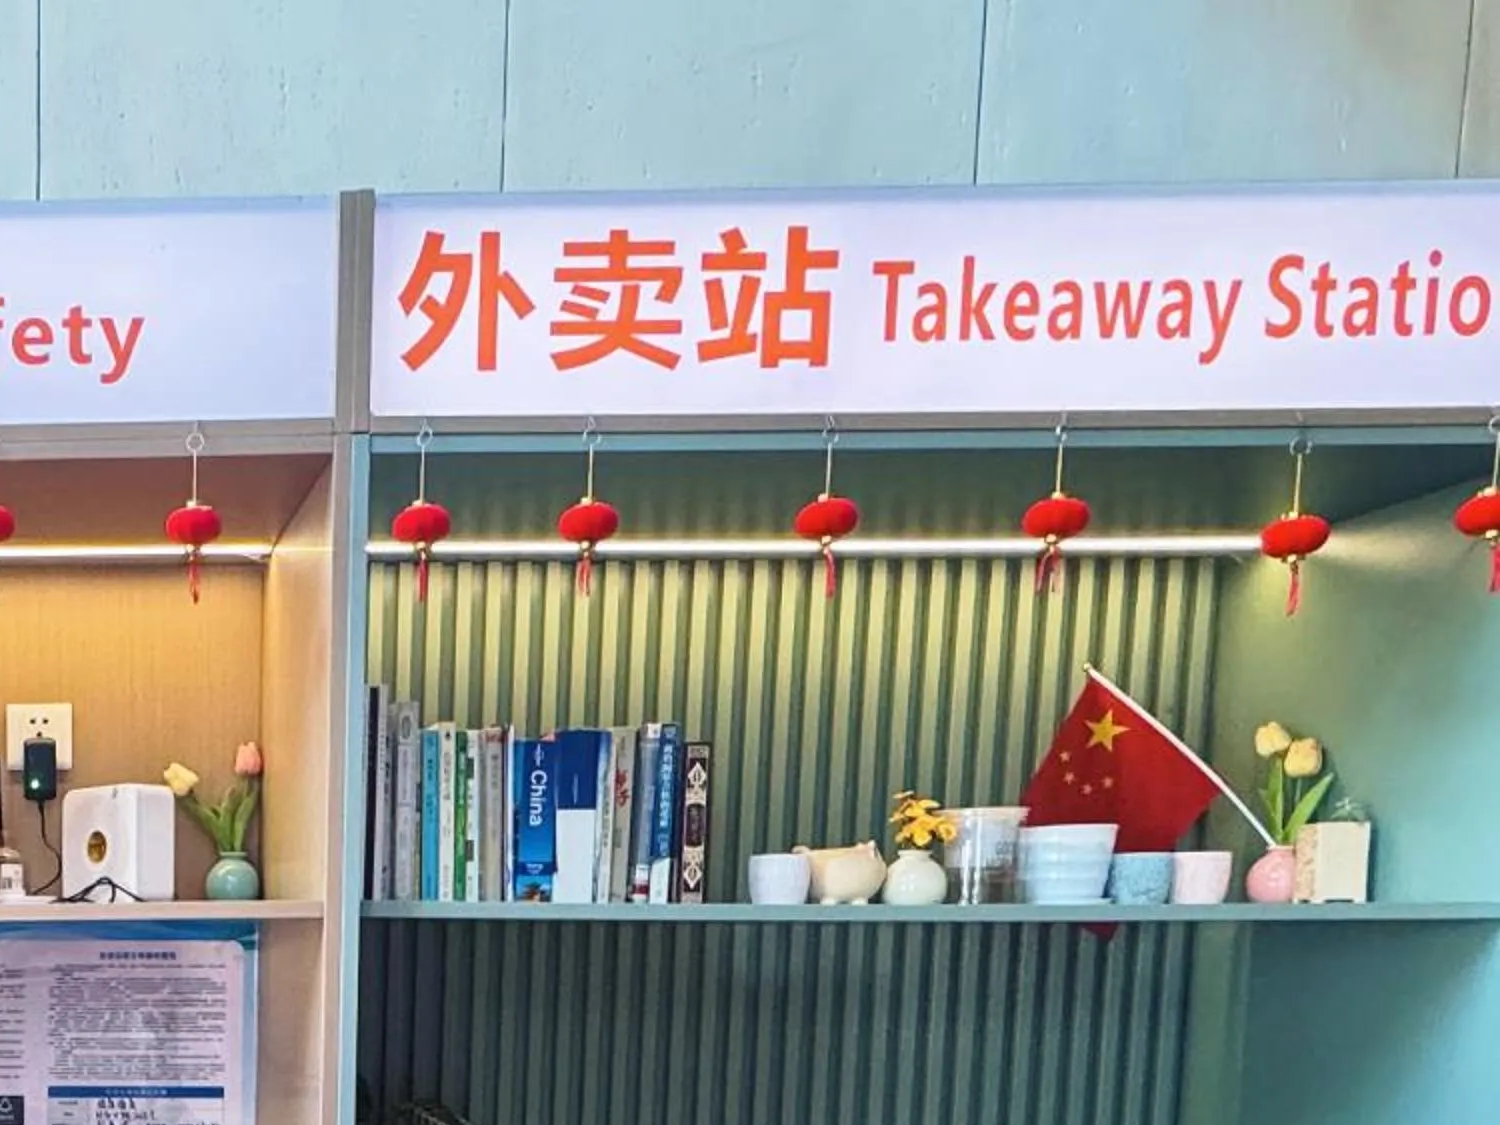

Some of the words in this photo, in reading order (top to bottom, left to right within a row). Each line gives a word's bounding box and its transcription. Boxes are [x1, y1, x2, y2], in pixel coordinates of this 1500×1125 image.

[398, 226, 839, 371] 外卖站
[873, 255, 1243, 365] Takeaway
[1264, 249, 1492, 338] Statio
[529, 770, 548, 827] China
